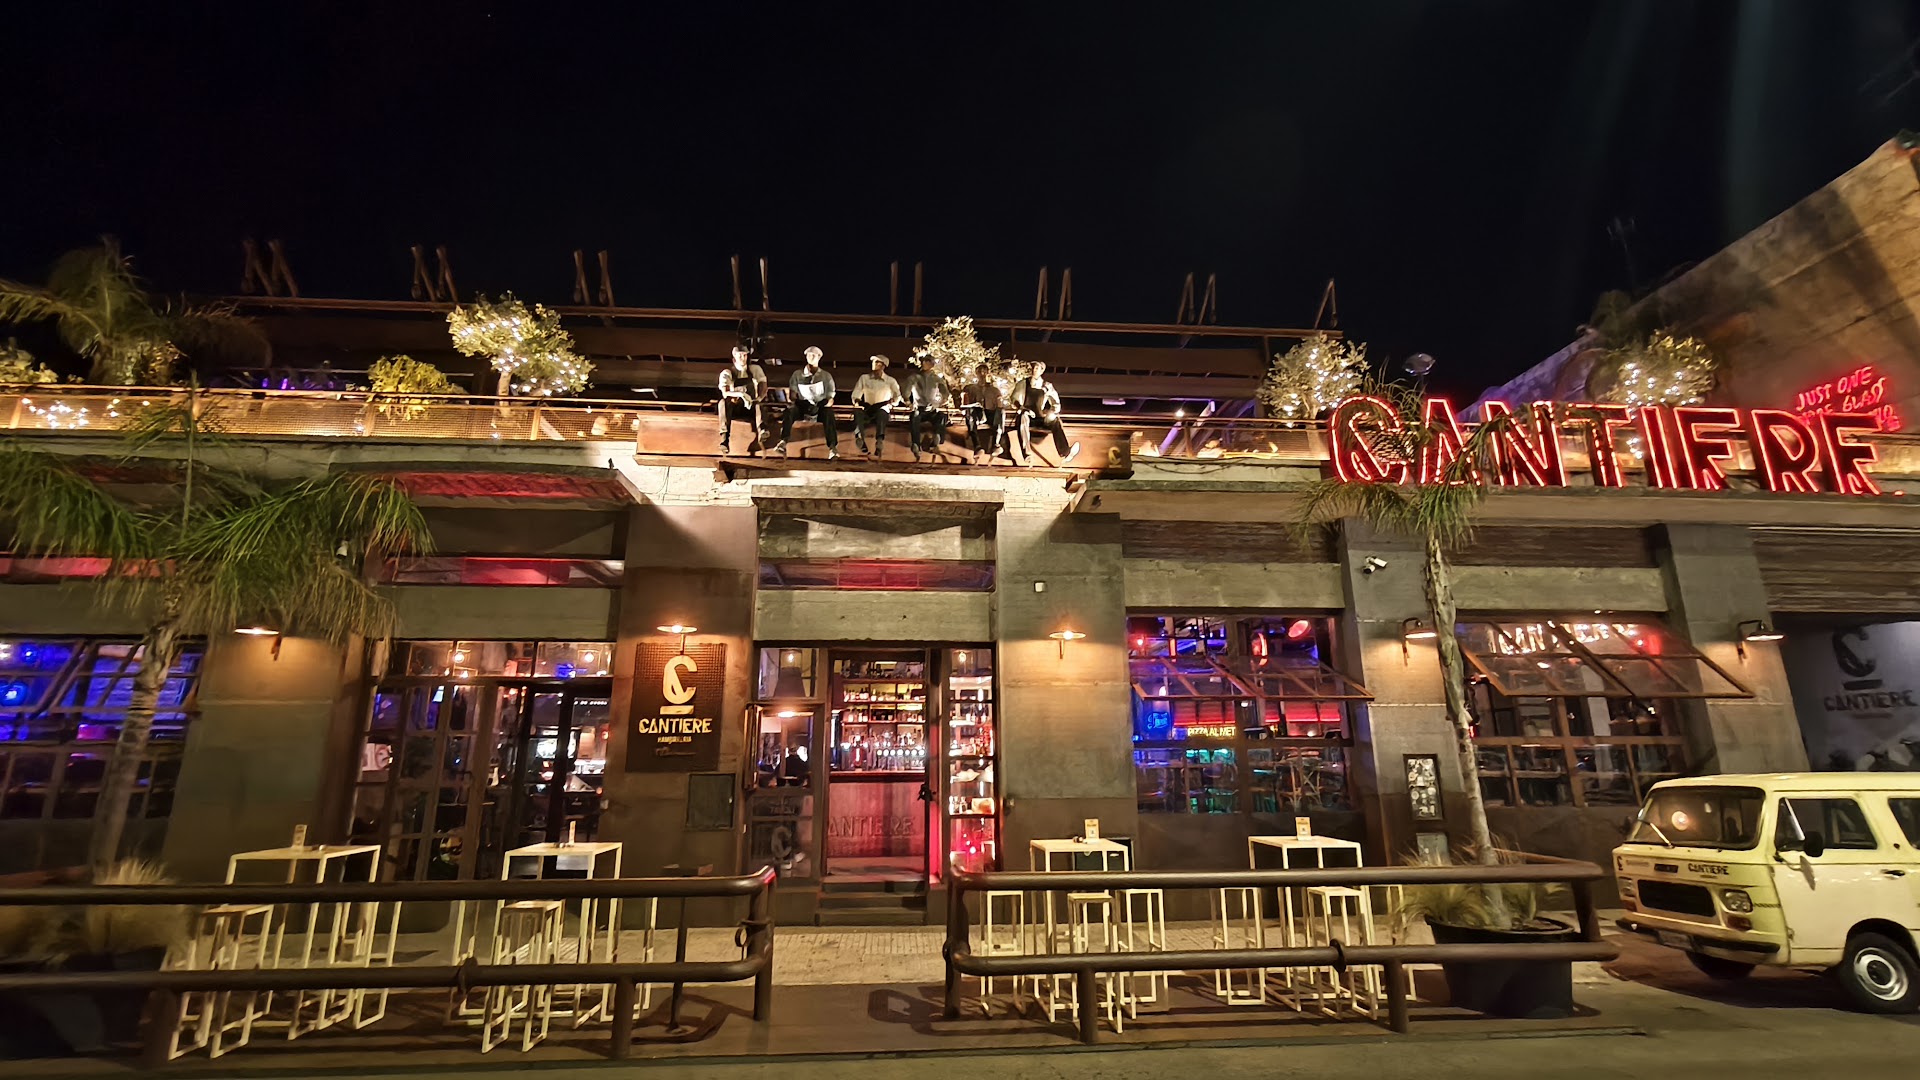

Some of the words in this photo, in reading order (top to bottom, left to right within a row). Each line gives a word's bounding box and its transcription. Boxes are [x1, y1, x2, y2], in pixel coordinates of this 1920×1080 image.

[1796, 383, 1832, 411] JUST
[1837, 366, 1872, 393] ONE
[1331, 395, 1883, 496] CANTIERE
[1824, 690, 1919, 712] CANTIERE
[638, 718, 713, 734] CANTIERE
[1187, 727, 1209, 737] PIZZA
[1209, 727, 1219, 737] AL
[828, 816, 913, 838] ANTIERE
[1687, 863, 1729, 876] CANTIERE
